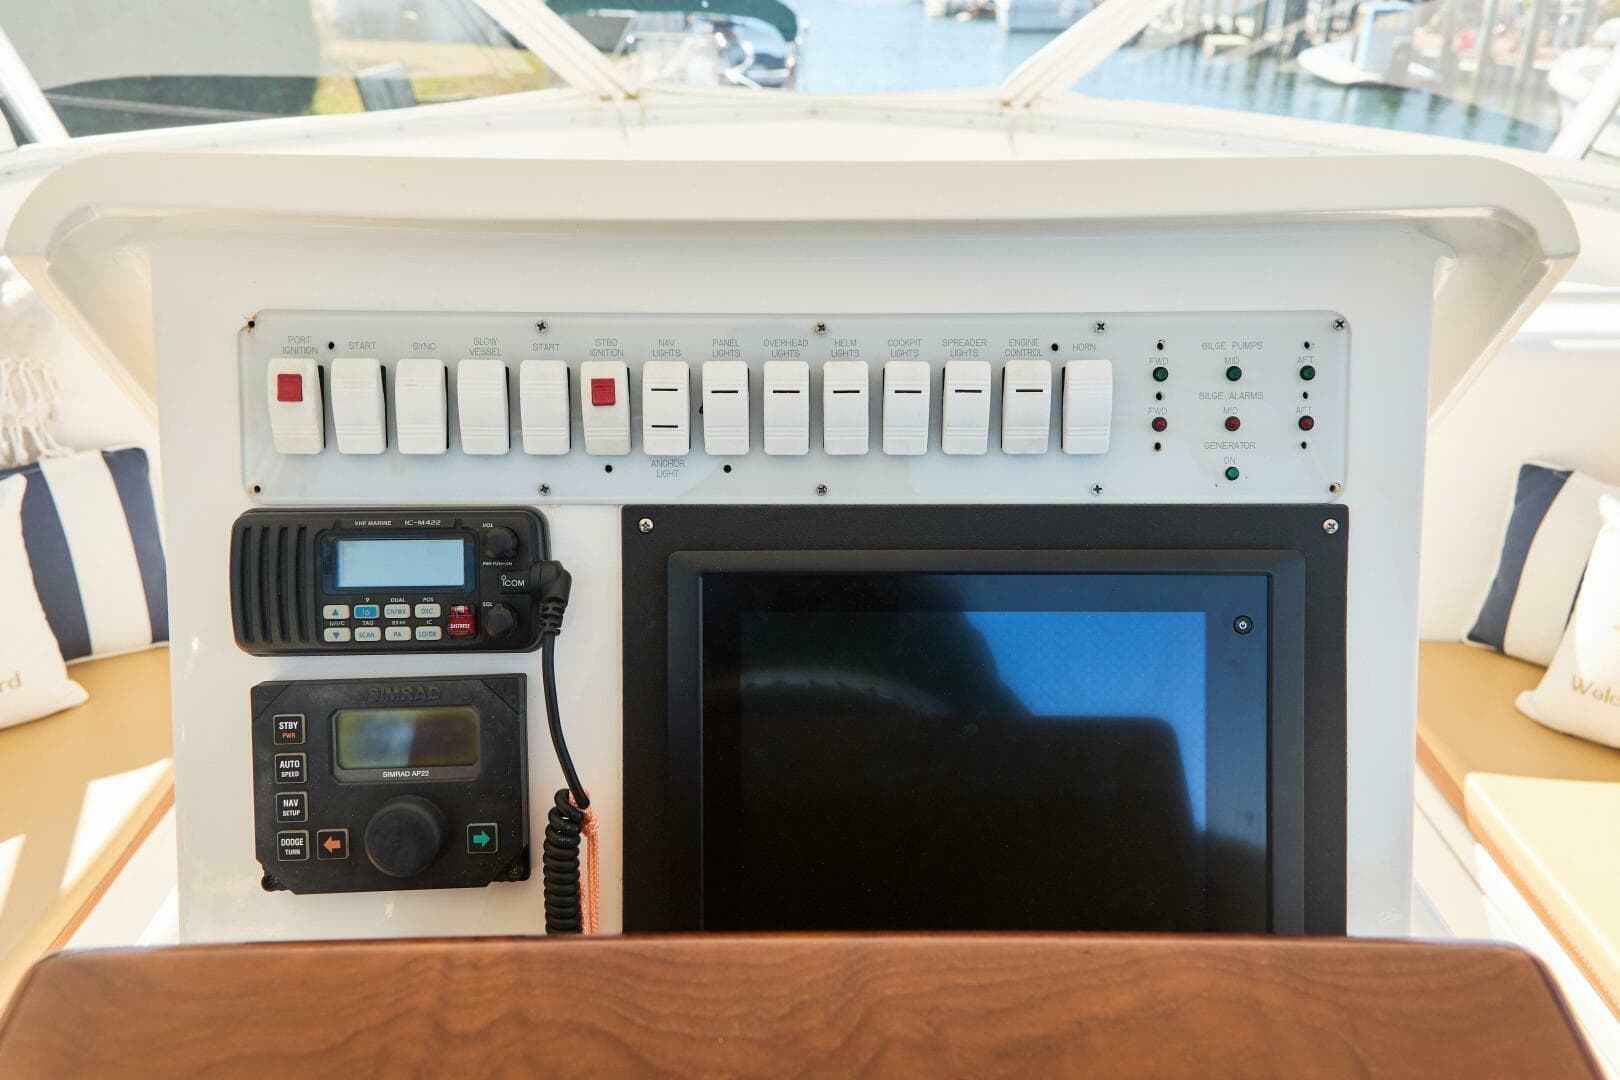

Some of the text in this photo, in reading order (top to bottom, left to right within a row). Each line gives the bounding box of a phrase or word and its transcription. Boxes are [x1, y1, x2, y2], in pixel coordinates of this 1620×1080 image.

[287, 336, 312, 344] PORT
[473, 338, 498, 346] SLOW
[594, 338, 618, 347] STBD
[658, 338, 675, 347] NAV
[712, 338, 740, 347] PANEL
[763, 338, 809, 347] OVERHEAD
[834, 338, 857, 347] HELM
[887, 338, 923, 347] COCKPIT
[942, 338, 987, 347] SPREADER
[1008, 338, 1040, 347] ENGINE
[348, 341, 376, 350] START
[412, 342, 436, 351] SYNC
[532, 343, 560, 351] START
[1072, 343, 1096, 351] HORN
[1201, 341, 1263, 350] BILGE PUMPS
[282, 346, 318, 355] IGNITION
[469, 348, 502, 356] VESSEL
[589, 349, 624, 357] IGNITION
[652, 349, 682, 358] LIGHTS
[712, 349, 741, 358] LIGHTS
[771, 349, 801, 358] LIGHTS
[831, 349, 860, 358] LIGHTS
[890, 349, 919, 358] LIGHTS
[950, 349, 979, 358] LIGHTS
[1004, 348, 1043, 357] CONTROL
[1149, 357, 1169, 365] FWD
[1224, 357, 1240, 365] MID
[1297, 356, 1314, 364] AFT
[1199, 391, 1263, 400] BILGE ALARMS
[1148, 407, 1168, 415] FWD
[1223, 406, 1239, 414] MID
[1296, 406, 1312, 414] AFT
[1204, 441, 1256, 450] GENERATOR
[651, 459, 685, 468] ANCHOR
[1223, 457, 1236, 465] ON
[656, 469, 679, 478] LIGHT
[360, 608, 370, 616] 16
[368, 686, 440, 701] SIMRAD
[278, 721, 299, 730] STBY
[279, 760, 300, 769] AUTO
[283, 799, 299, 807] NAV
[280, 838, 304, 847] DODGE
